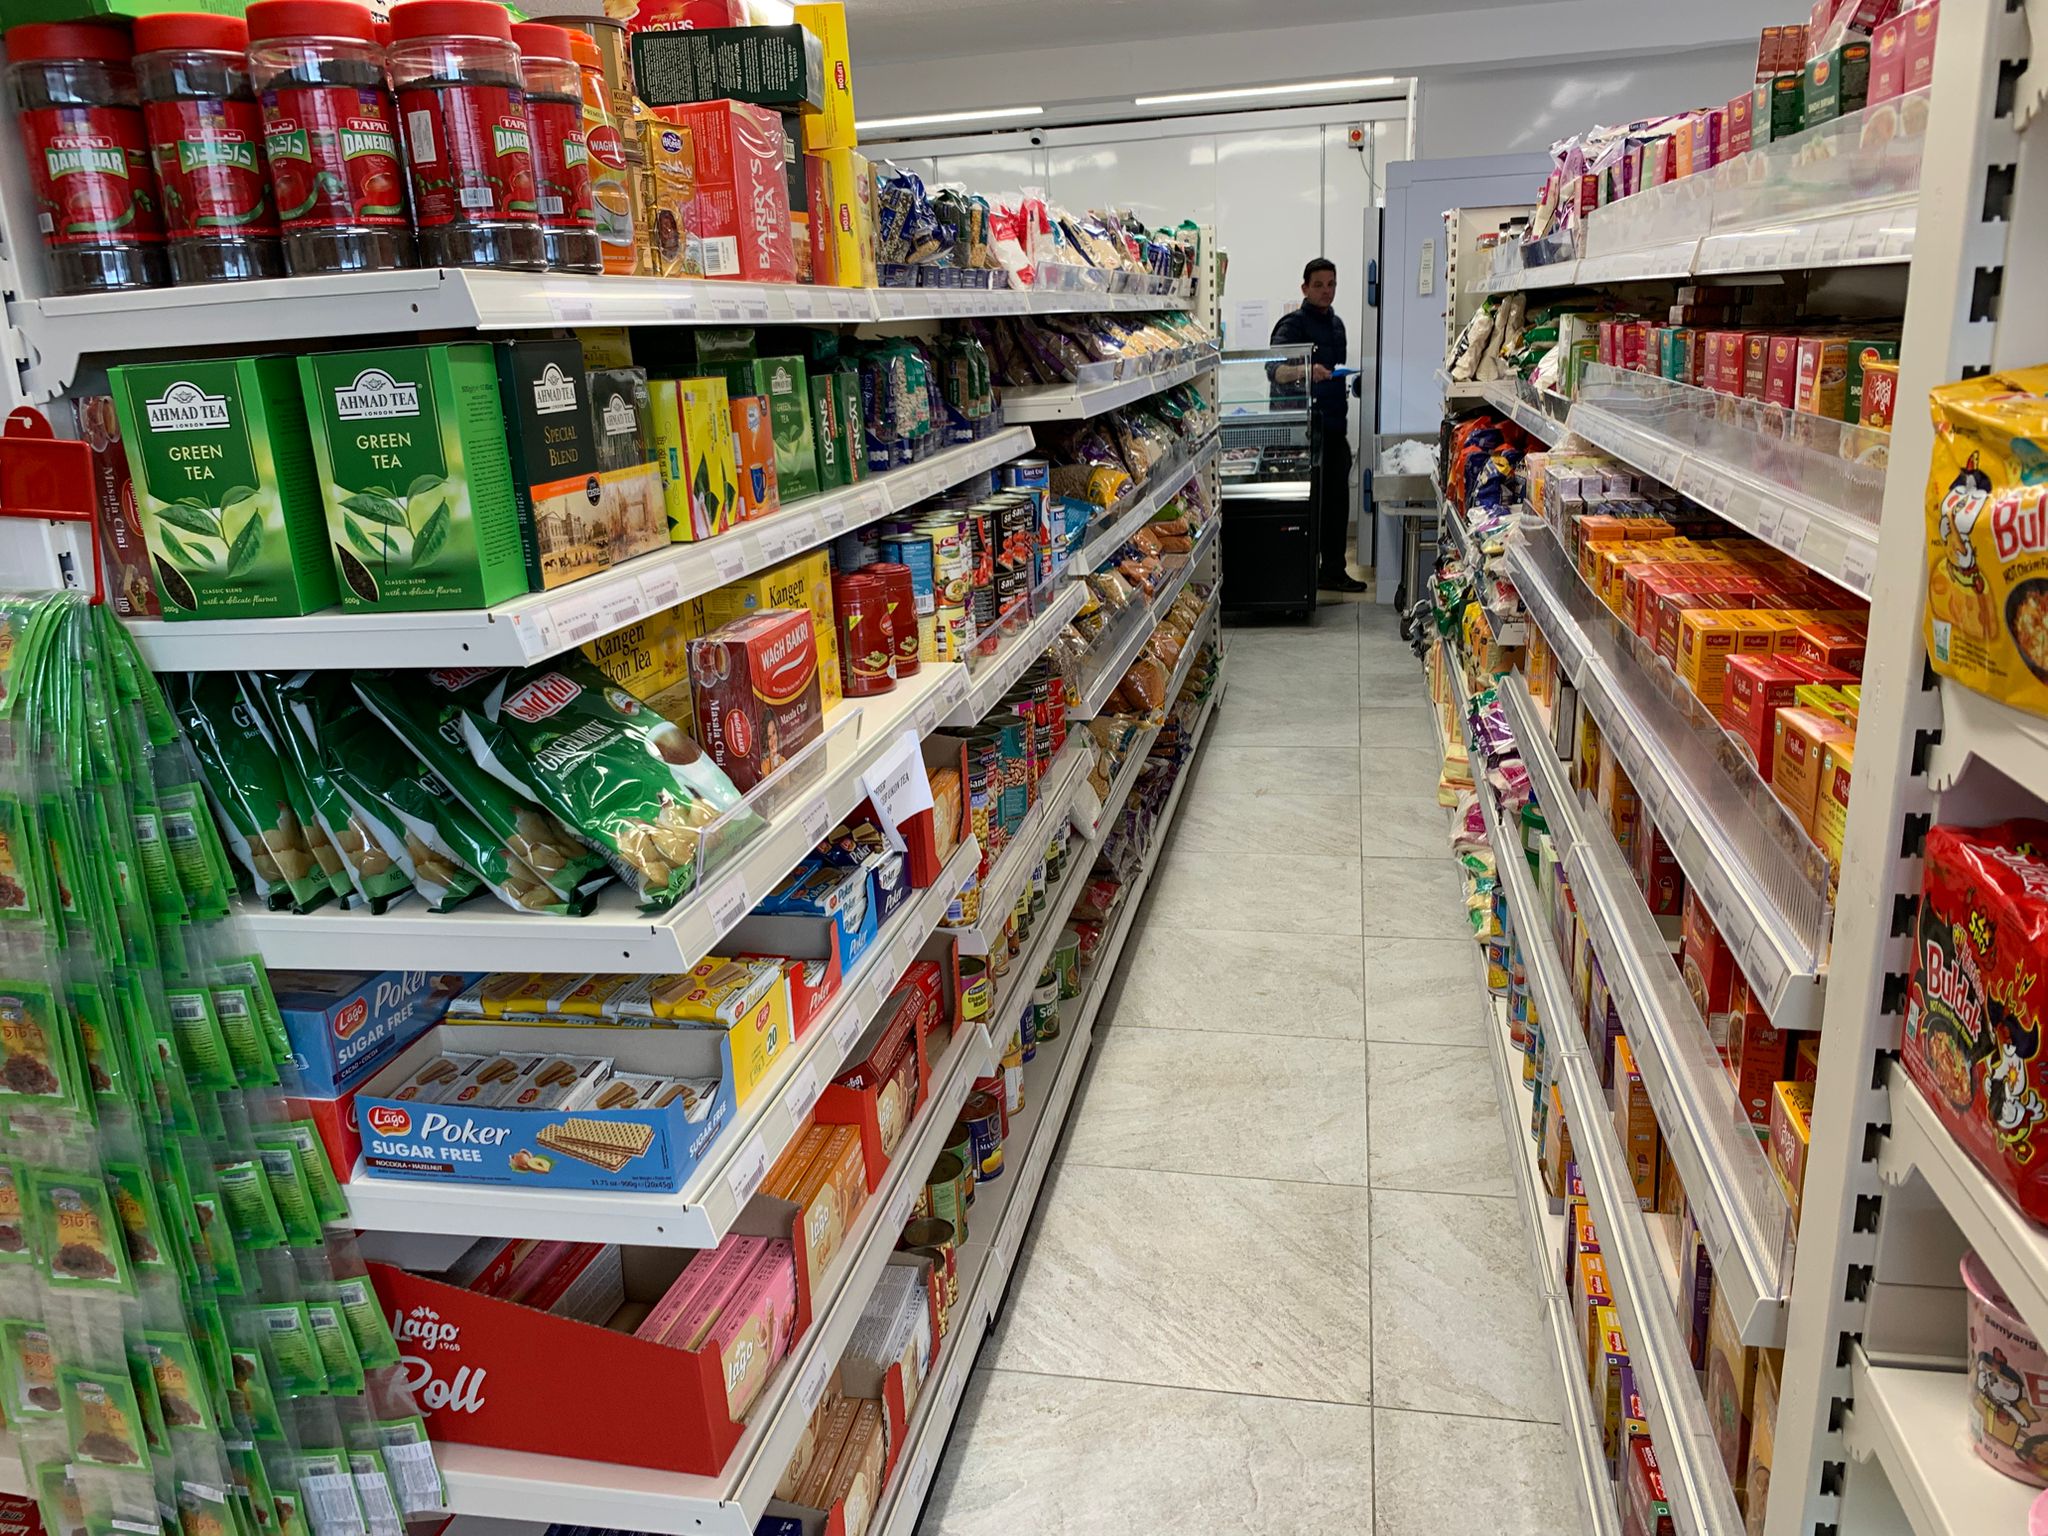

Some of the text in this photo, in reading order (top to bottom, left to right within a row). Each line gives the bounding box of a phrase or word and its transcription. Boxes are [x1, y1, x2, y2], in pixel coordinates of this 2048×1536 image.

[836, 62, 845, 90] LIPTON
[350, 120, 390, 132] TAPAL
[49, 151, 125, 174] DANDAR
[751, 158, 771, 270] BARRY'S
[764, 187, 780, 245] TEA
[841, 205, 850, 232] LIPTON
[339, 391, 417, 410] AHMAD TEA
[536, 387, 576, 405] AHMAD TEA
[150, 404, 227, 423] AHMAD TEA
[175, 421, 205, 429] LONDON
[364, 409, 394, 417] LONDON
[356, 432, 412, 450] GREEN
[543, 424, 578, 445] SPECIAL
[819, 398, 836, 466] LYONS
[848, 395, 864, 461] LYONS
[169, 443, 223, 461] GREEN
[371, 453, 403, 470] TEA
[548, 448, 579, 467] BLEND
[184, 465, 216, 480] TEA
[103, 466, 129, 550] Masala Chai
[768, 577, 805, 608] Kangen
[593, 622, 645, 662] Kangen
[761, 621, 809, 672] WAGH BAKRI
[630, 648, 652, 673] Tea
[779, 707, 797, 725] Masala
[709, 700, 726, 767] Masala Chai
[848, 844, 871, 865] Poker
[884, 887, 903, 914] Poker
[849, 928, 868, 960] Poker
[338, 971, 429, 1032] Lago Poker
[808, 981, 831, 1016] Poker
[1926, 939, 1982, 1043] Buldak
[338, 1002, 415, 1066] SUGAR FREE
[766, 1026, 778, 1053] 20
[373, 1108, 513, 1146] Lago Poker
[688, 1100, 728, 1159] SUGAR FREE
[371, 1139, 483, 1163] SUGAR FREE
[644, 1180, 674, 1190] (20x45g)
[810, 1207, 831, 1250] Lago
[390, 1309, 460, 1351] Lago
[1984, 1313, 2039, 1351] Samyang
[439, 1341, 461, 1352] 1968
[727, 1341, 754, 1393] Lago
[386, 1354, 487, 1418] Roll
